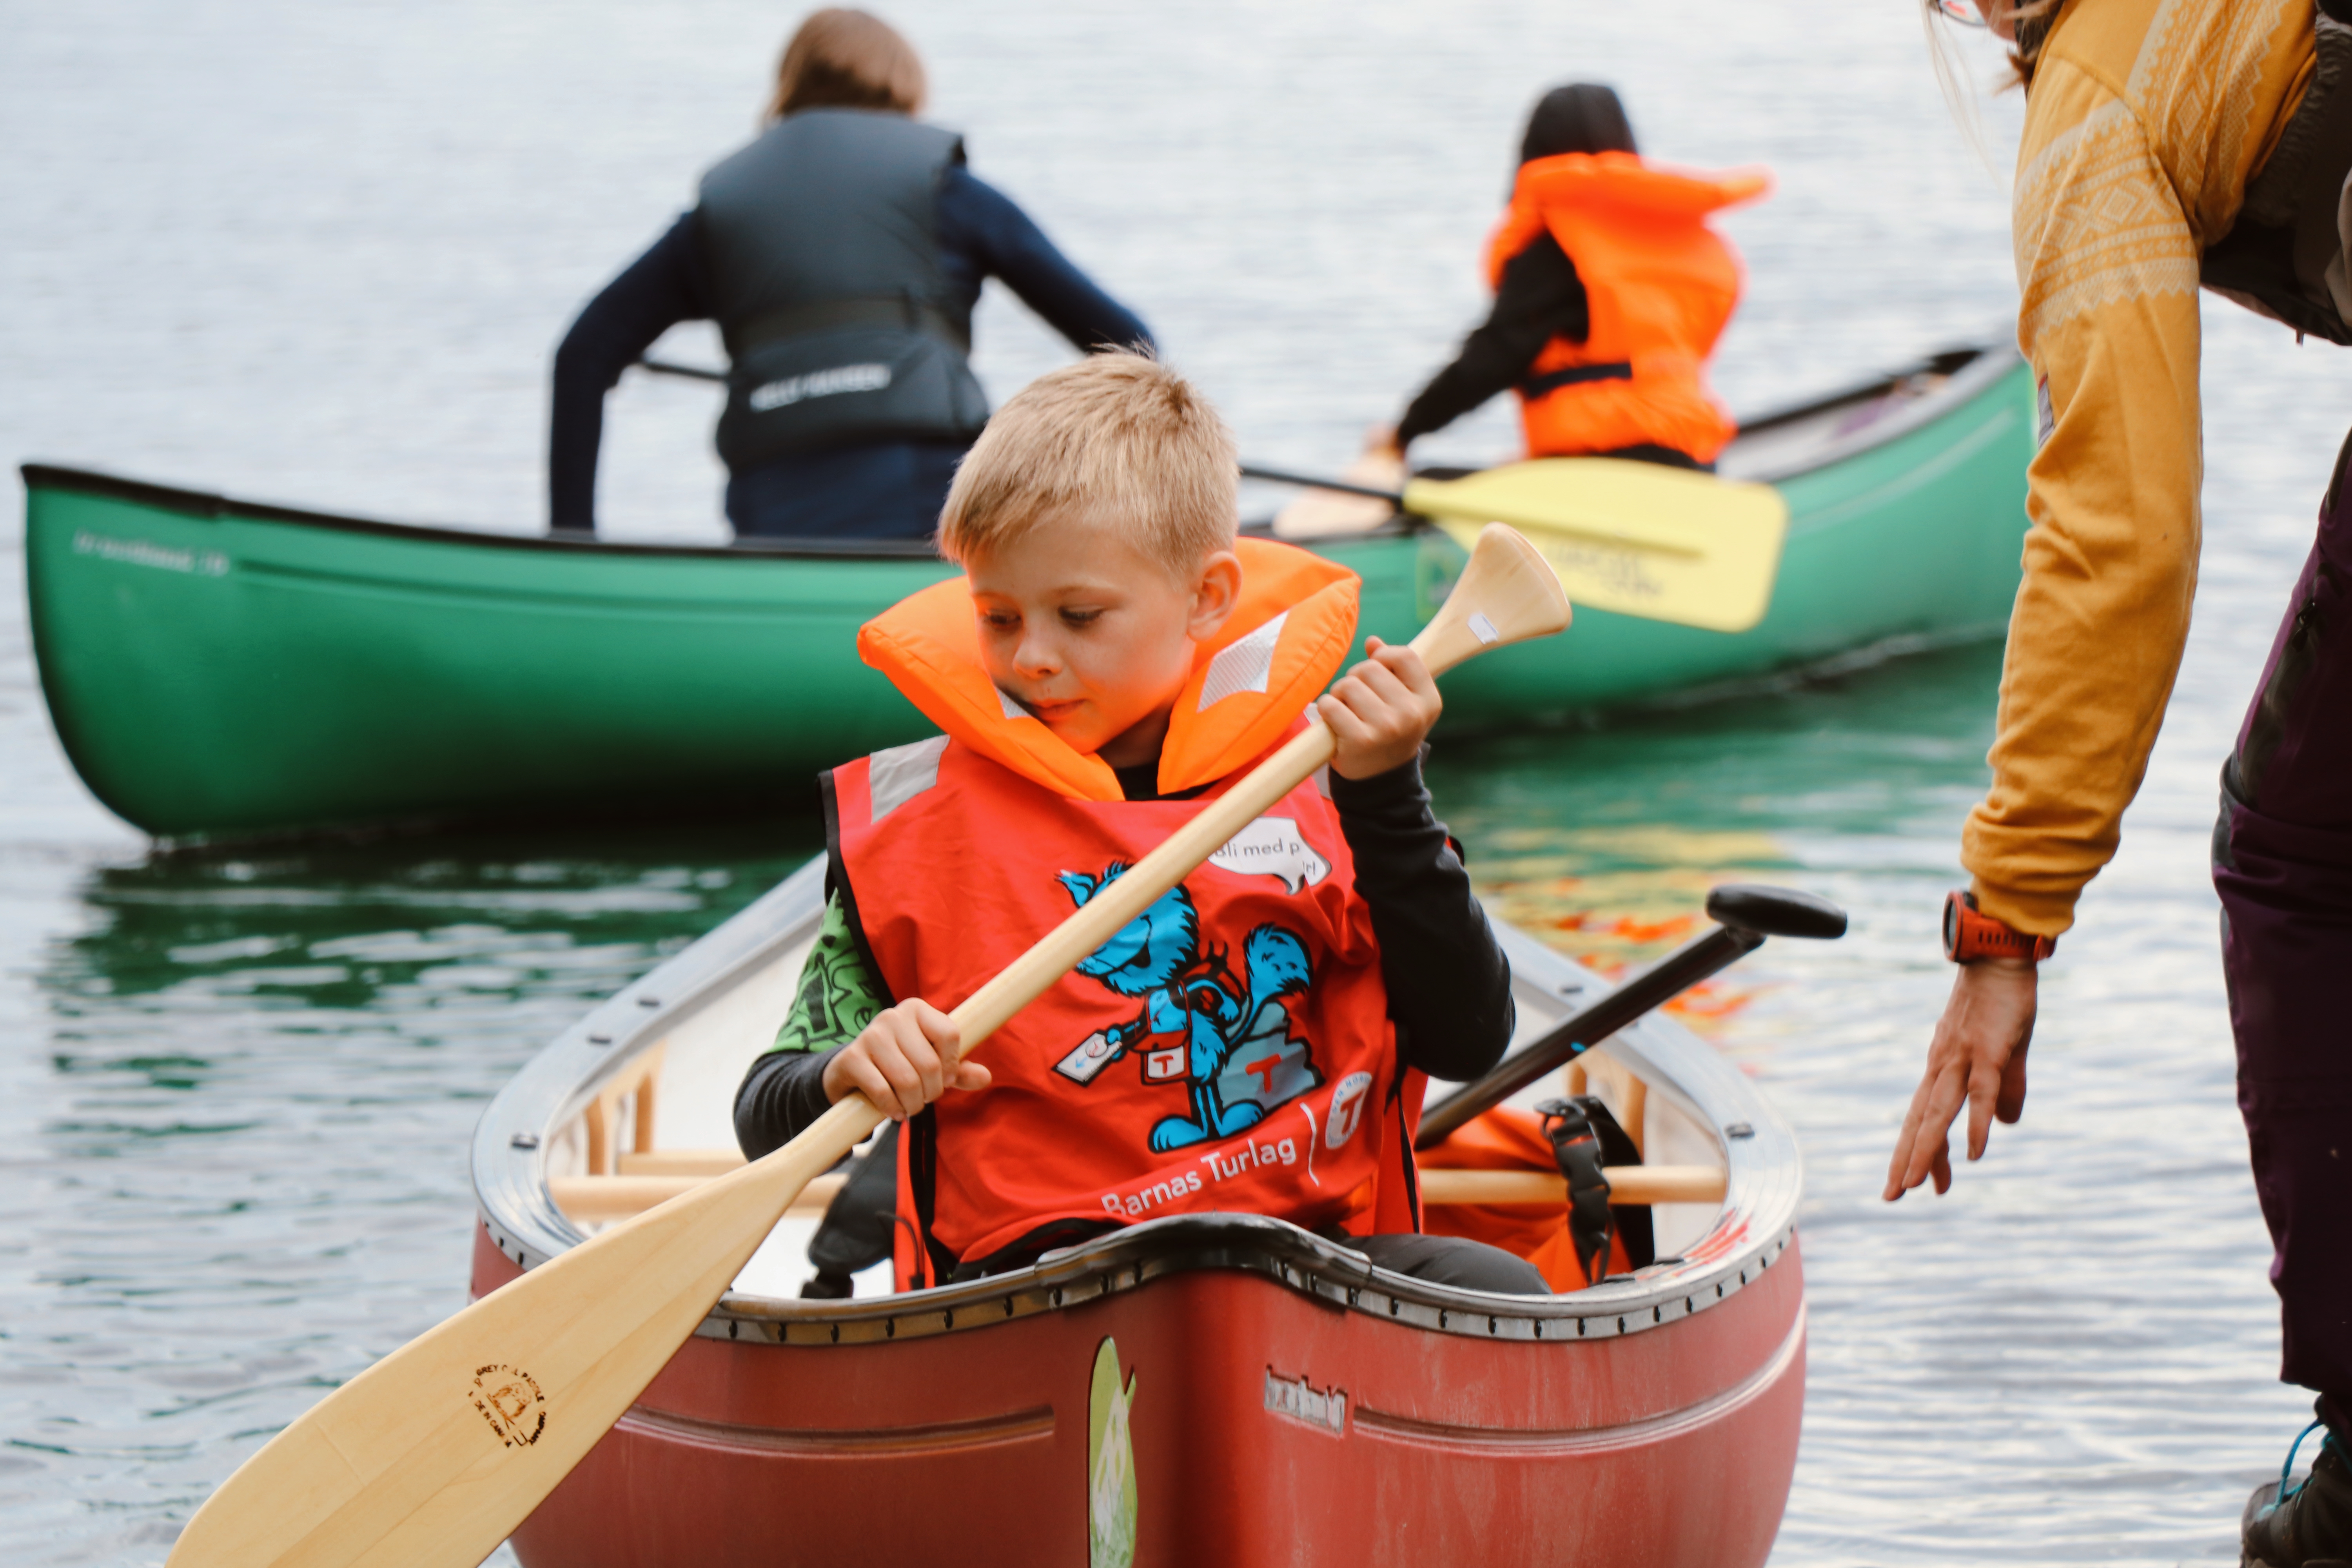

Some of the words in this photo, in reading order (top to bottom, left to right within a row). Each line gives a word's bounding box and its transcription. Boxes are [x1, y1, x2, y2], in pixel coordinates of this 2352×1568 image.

[1243, 837, 1283, 856] med
[1101, 1171, 1202, 1215] Barnas
[1200, 1138, 1296, 1181] Turlag
[476, 1364, 498, 1376] GREY
